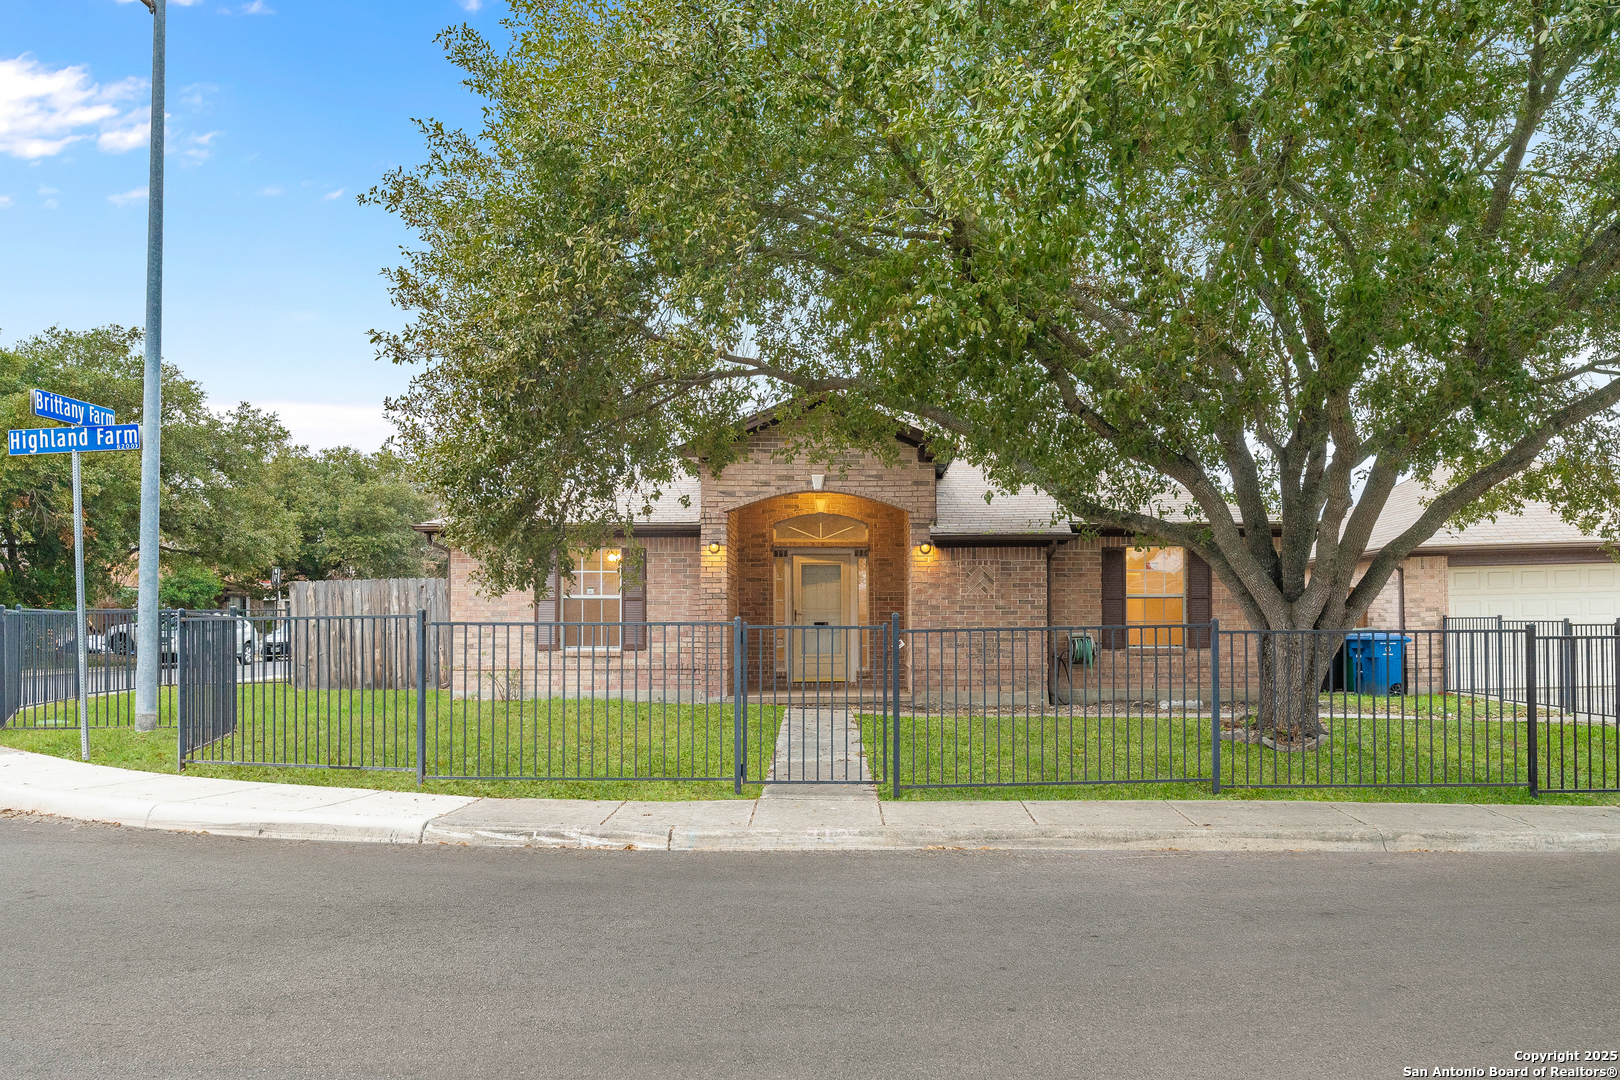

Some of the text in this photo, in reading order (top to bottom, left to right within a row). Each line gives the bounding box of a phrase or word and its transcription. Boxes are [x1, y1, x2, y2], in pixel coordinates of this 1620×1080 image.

[36, 391, 115, 425] Brittany Farm
[10, 428, 138, 453] Highland Farm
